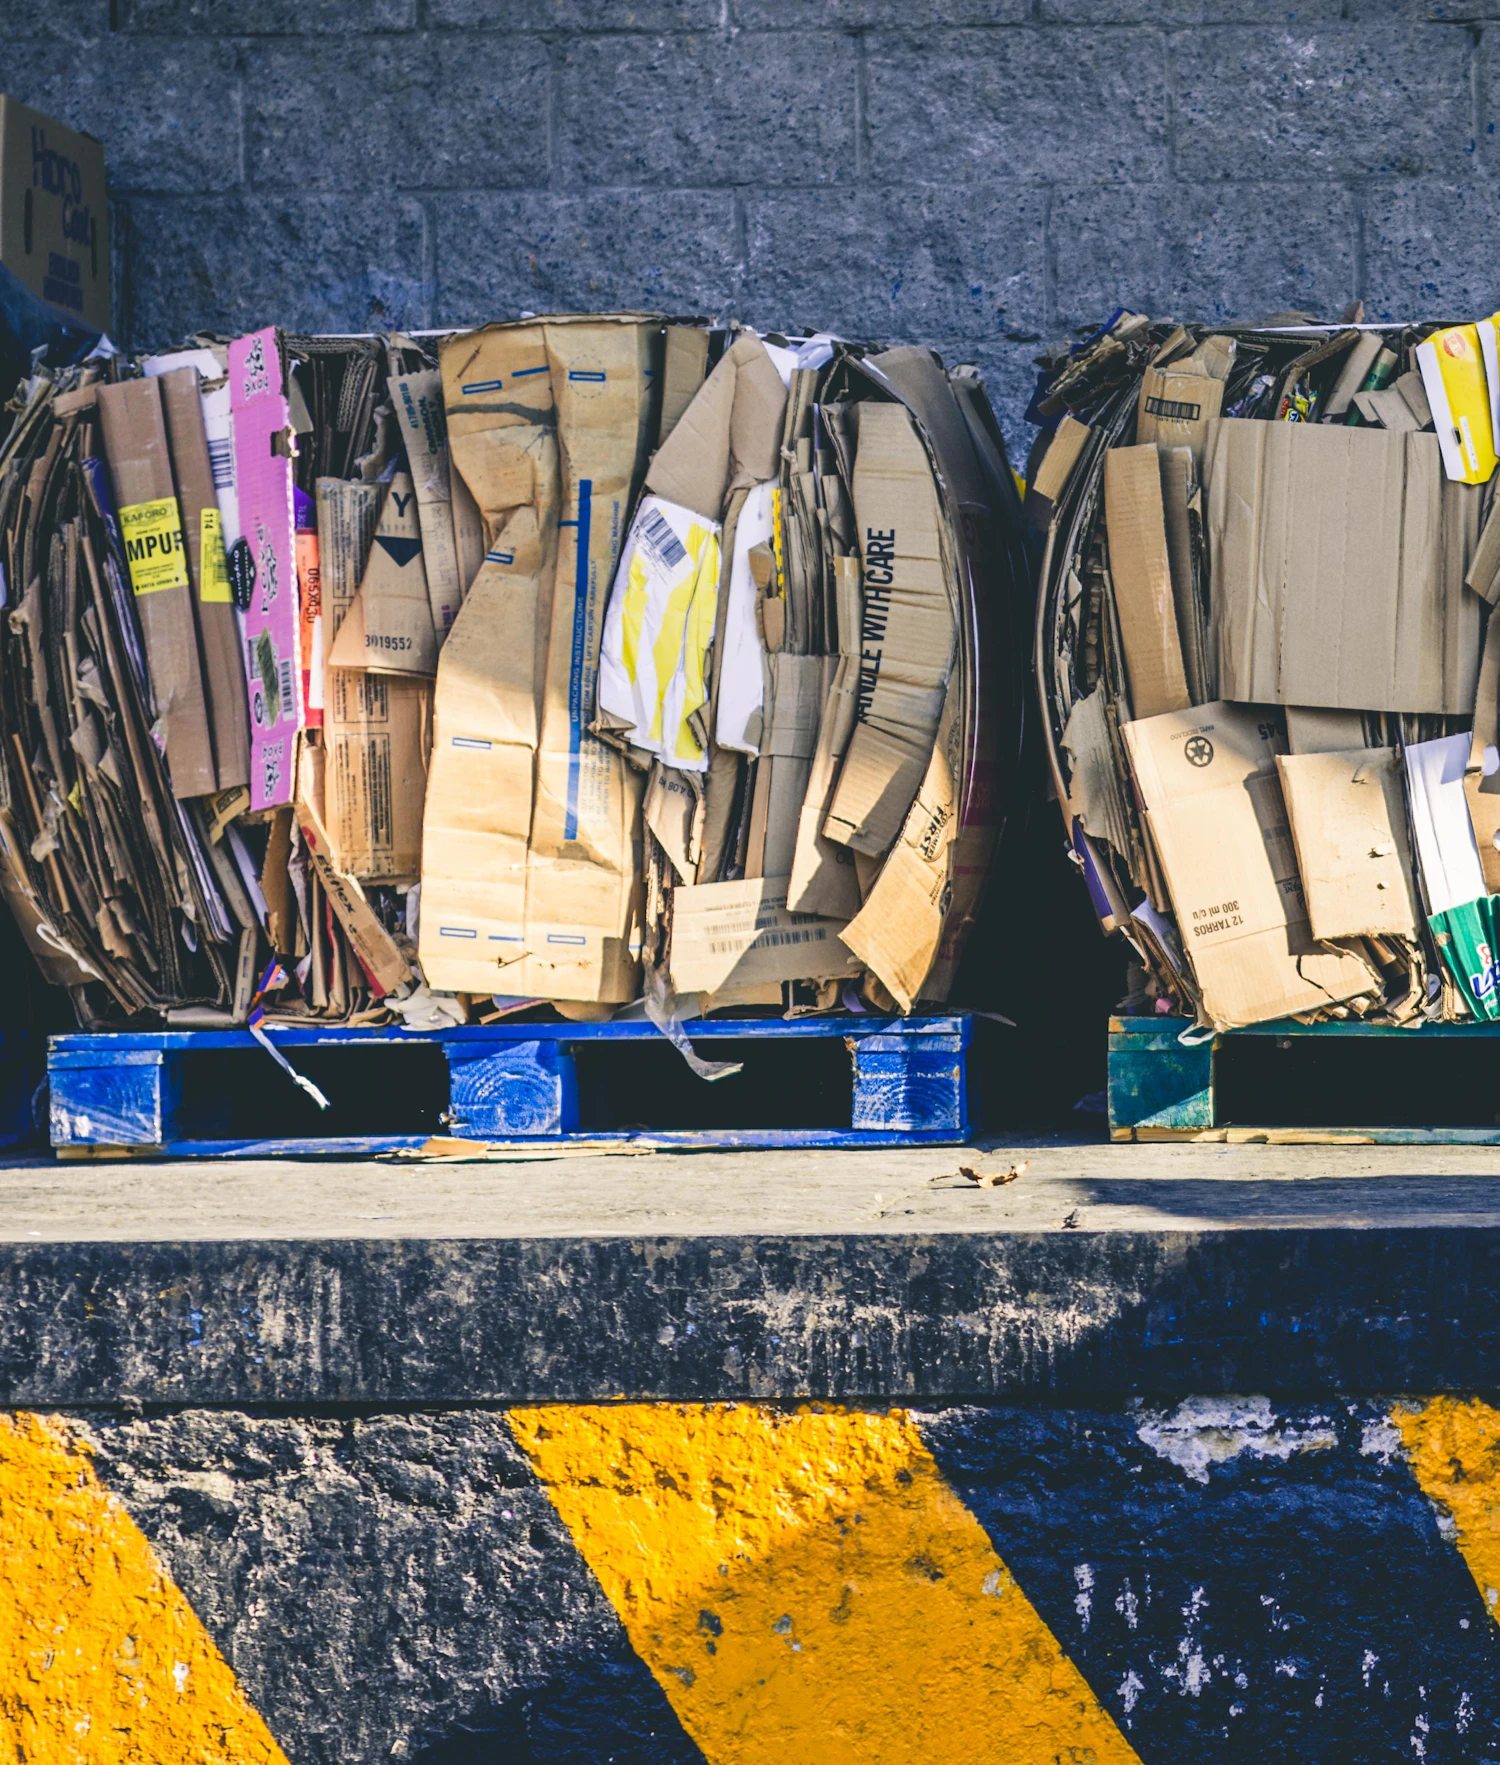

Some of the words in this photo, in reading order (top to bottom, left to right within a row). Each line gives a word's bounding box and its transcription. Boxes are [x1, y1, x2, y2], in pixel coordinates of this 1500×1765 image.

[391, 492, 412, 517] Y
[204, 513, 214, 529] 114
[611, 500, 620, 538] MACHINE
[866, 528, 895, 584] CARE
[589, 559, 597, 607] CAREFULLY
[587, 610, 595, 643] CARTON
[862, 588, 892, 641] WITH
[574, 596, 585, 666] INSTRUCTIONS
[571, 667, 581, 723] UNPACKING
[1199, 724, 1215, 733] PAPEL
[668, 781, 686, 794] 4.08
[920, 805, 945, 857] FIRST
[1193, 909, 1207, 921] c/u
[1208, 904, 1220, 918] ml
[1222, 900, 1240, 914] 300
[1194, 918, 1231, 937] TARROS
[1232, 915, 1245, 926] 12
